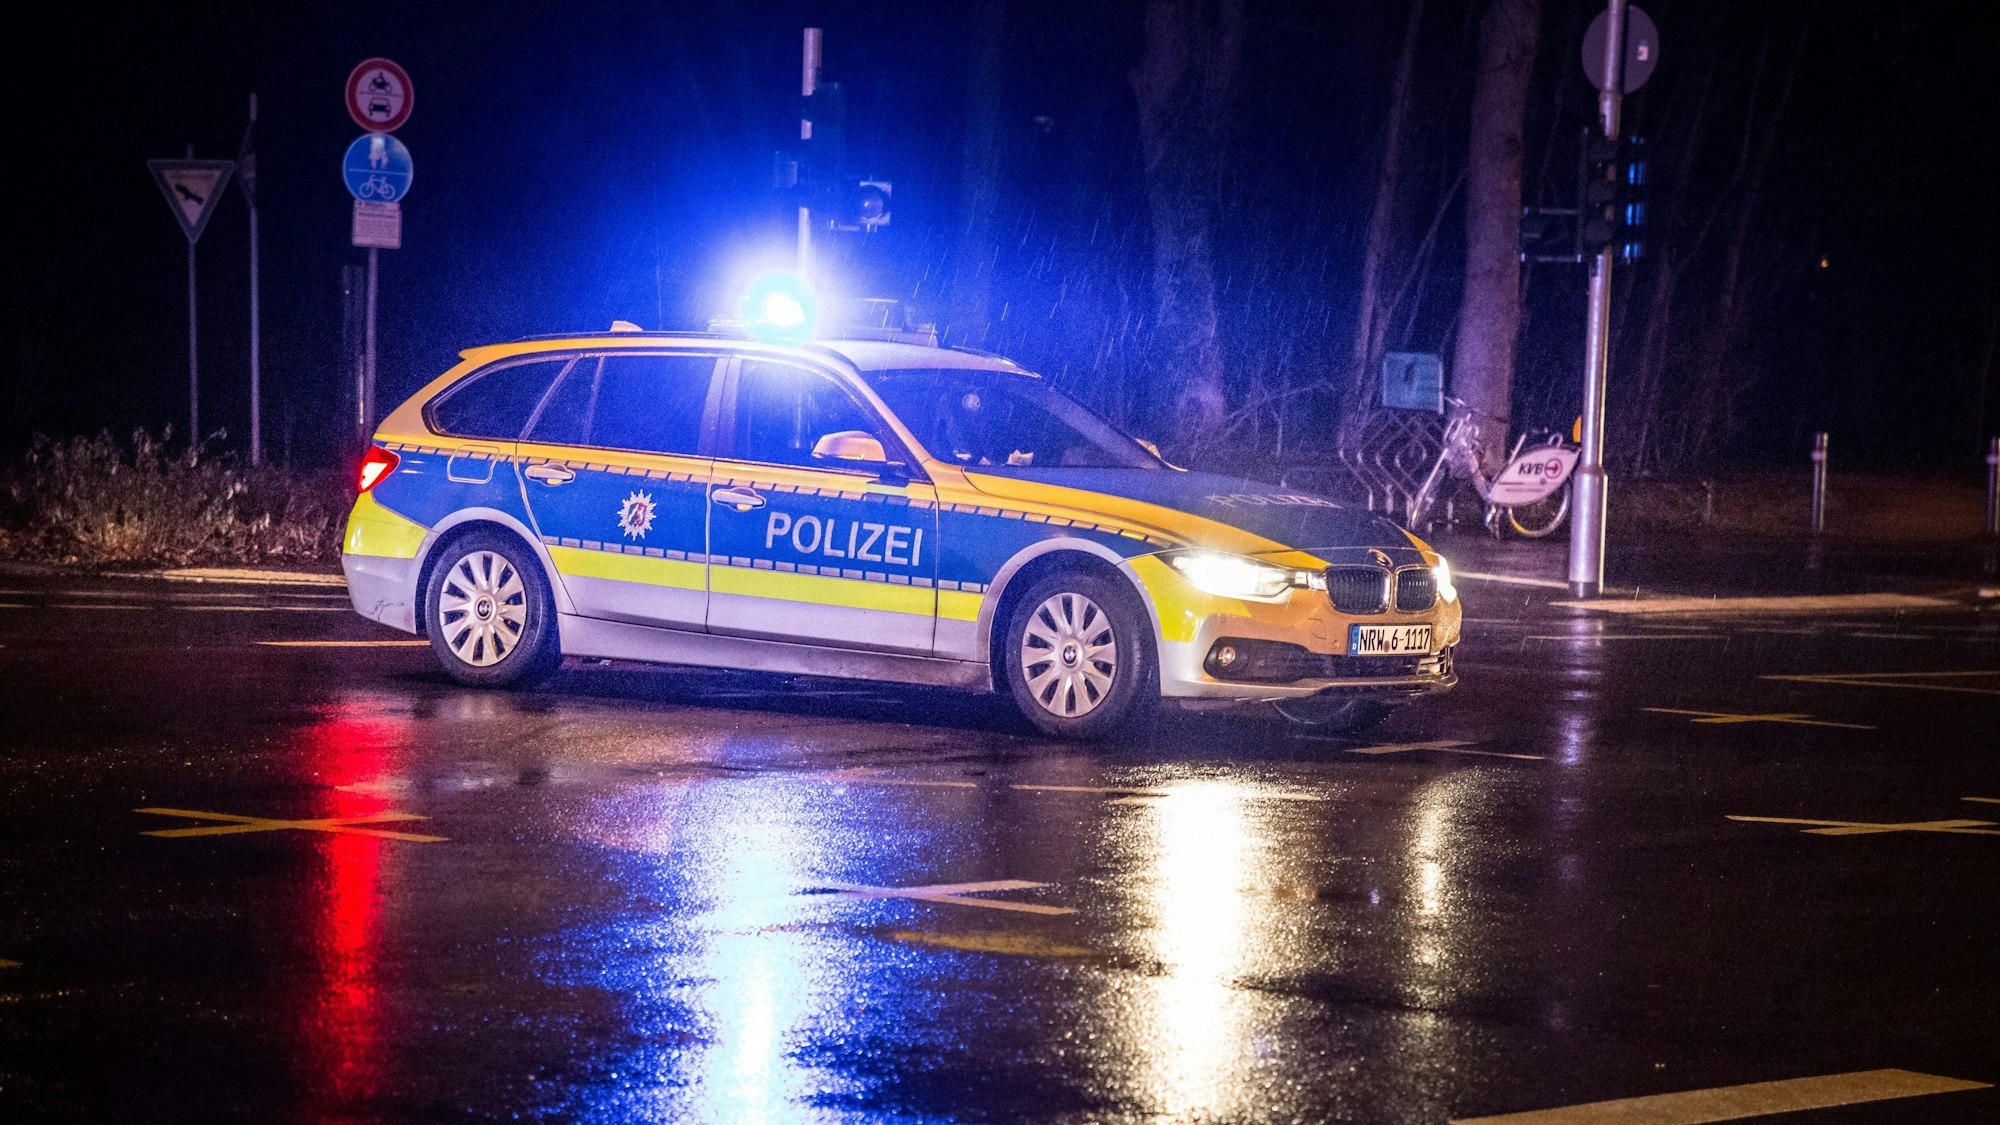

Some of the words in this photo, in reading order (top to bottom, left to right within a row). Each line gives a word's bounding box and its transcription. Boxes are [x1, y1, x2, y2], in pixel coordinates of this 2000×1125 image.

[1518, 462, 1544, 475] KVB
[765, 511, 923, 567] POLIZEI
[1360, 629, 1385, 651] NRW
[1391, 628, 1431, 651] 6-1117
